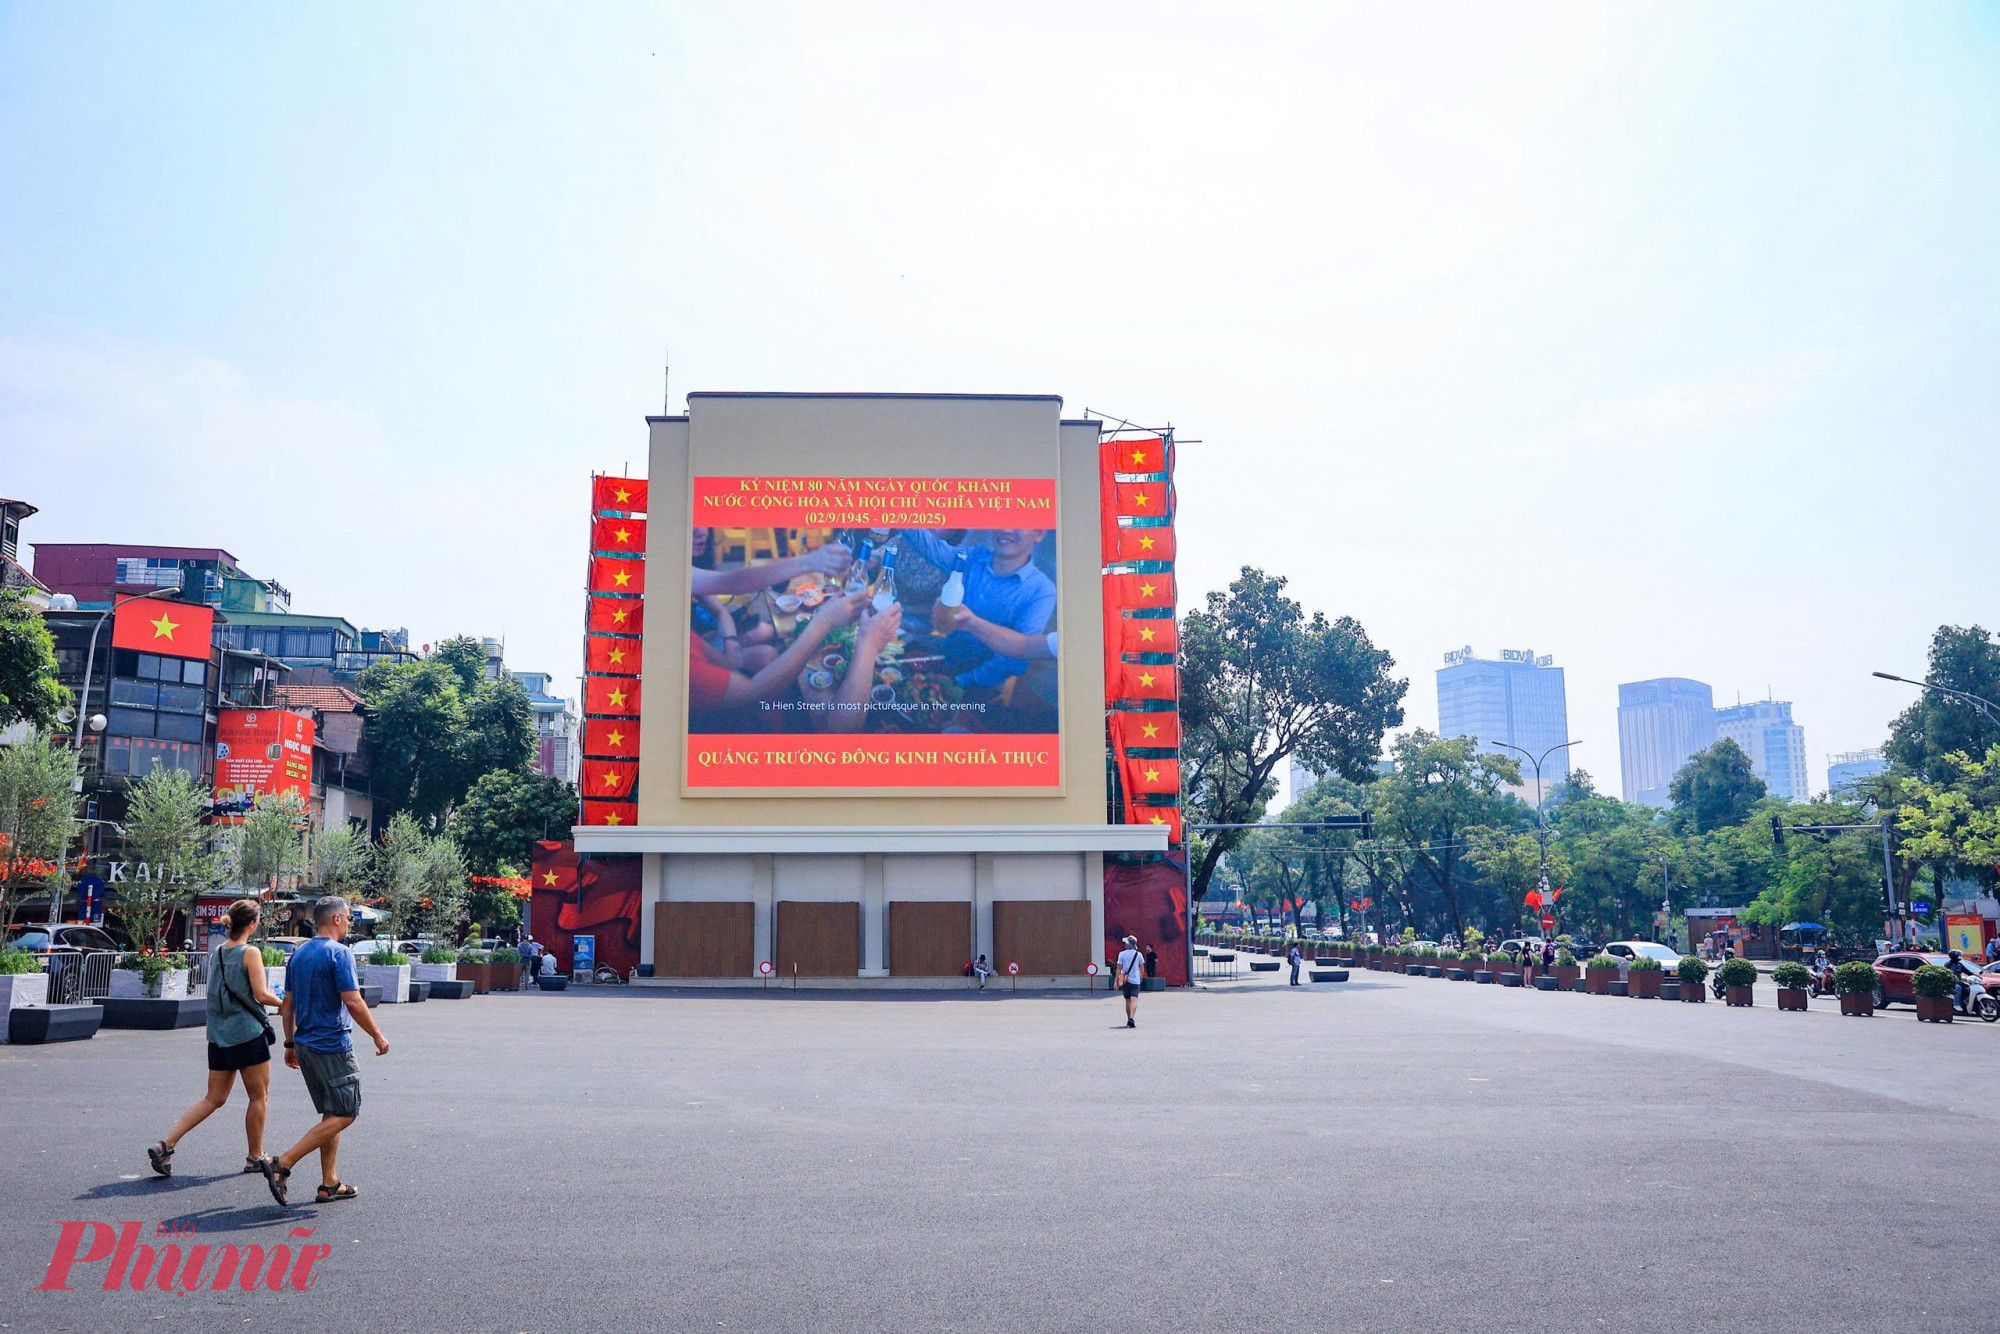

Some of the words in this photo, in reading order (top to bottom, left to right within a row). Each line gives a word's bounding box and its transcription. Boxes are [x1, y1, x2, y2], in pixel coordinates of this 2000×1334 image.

[765, 480, 804, 494] NIỆM
[808, 480, 822, 491] 80
[827, 477, 860, 492] NĂM
[865, 478, 906, 492] NGÀY
[910, 478, 953, 494] QUỐC
[958, 479, 1010, 493] KHÁNH
[703, 494, 746, 508] NƯỚC
[750, 495, 793, 510] CỘNG
[798, 494, 830, 508] HÒA
[834, 494, 854, 508] XÃ
[858, 495, 886, 510] HỘI
[890, 493, 921, 508] CHỦ
[926, 495, 974, 508] NGHĨA
[978, 496, 1014, 511] VIỆT
[1016, 498, 1050, 509] NAM
[805, 512, 870, 526] (02/9/1945
[881, 512, 946, 526] 02/9/2025)
[1444, 648, 1464, 664] BIDV
[1503, 650, 1526, 660] BIDV
[760, 701, 770, 710] Ta
[773, 701, 794, 710] Hien
[797, 701, 825, 710] Street
[828, 701, 835, 710] is
[837, 702, 861, 710] most
[864, 702, 918, 712] picturesque
[921, 702, 930, 710] in
[932, 701, 948, 710] the
[950, 702, 986, 712] evening
[698, 748, 759, 766] QUẢNG
[764, 748, 836, 764] TRƯỜNG
[842, 748, 890, 764] ĐÔNG
[895, 751, 938, 764] KINH
[943, 749, 998, 764] NGHĨA
[1002, 751, 1049, 768] THỤC
[196, 905, 208, 916] SIM
[208, 905, 216, 916] 5G
